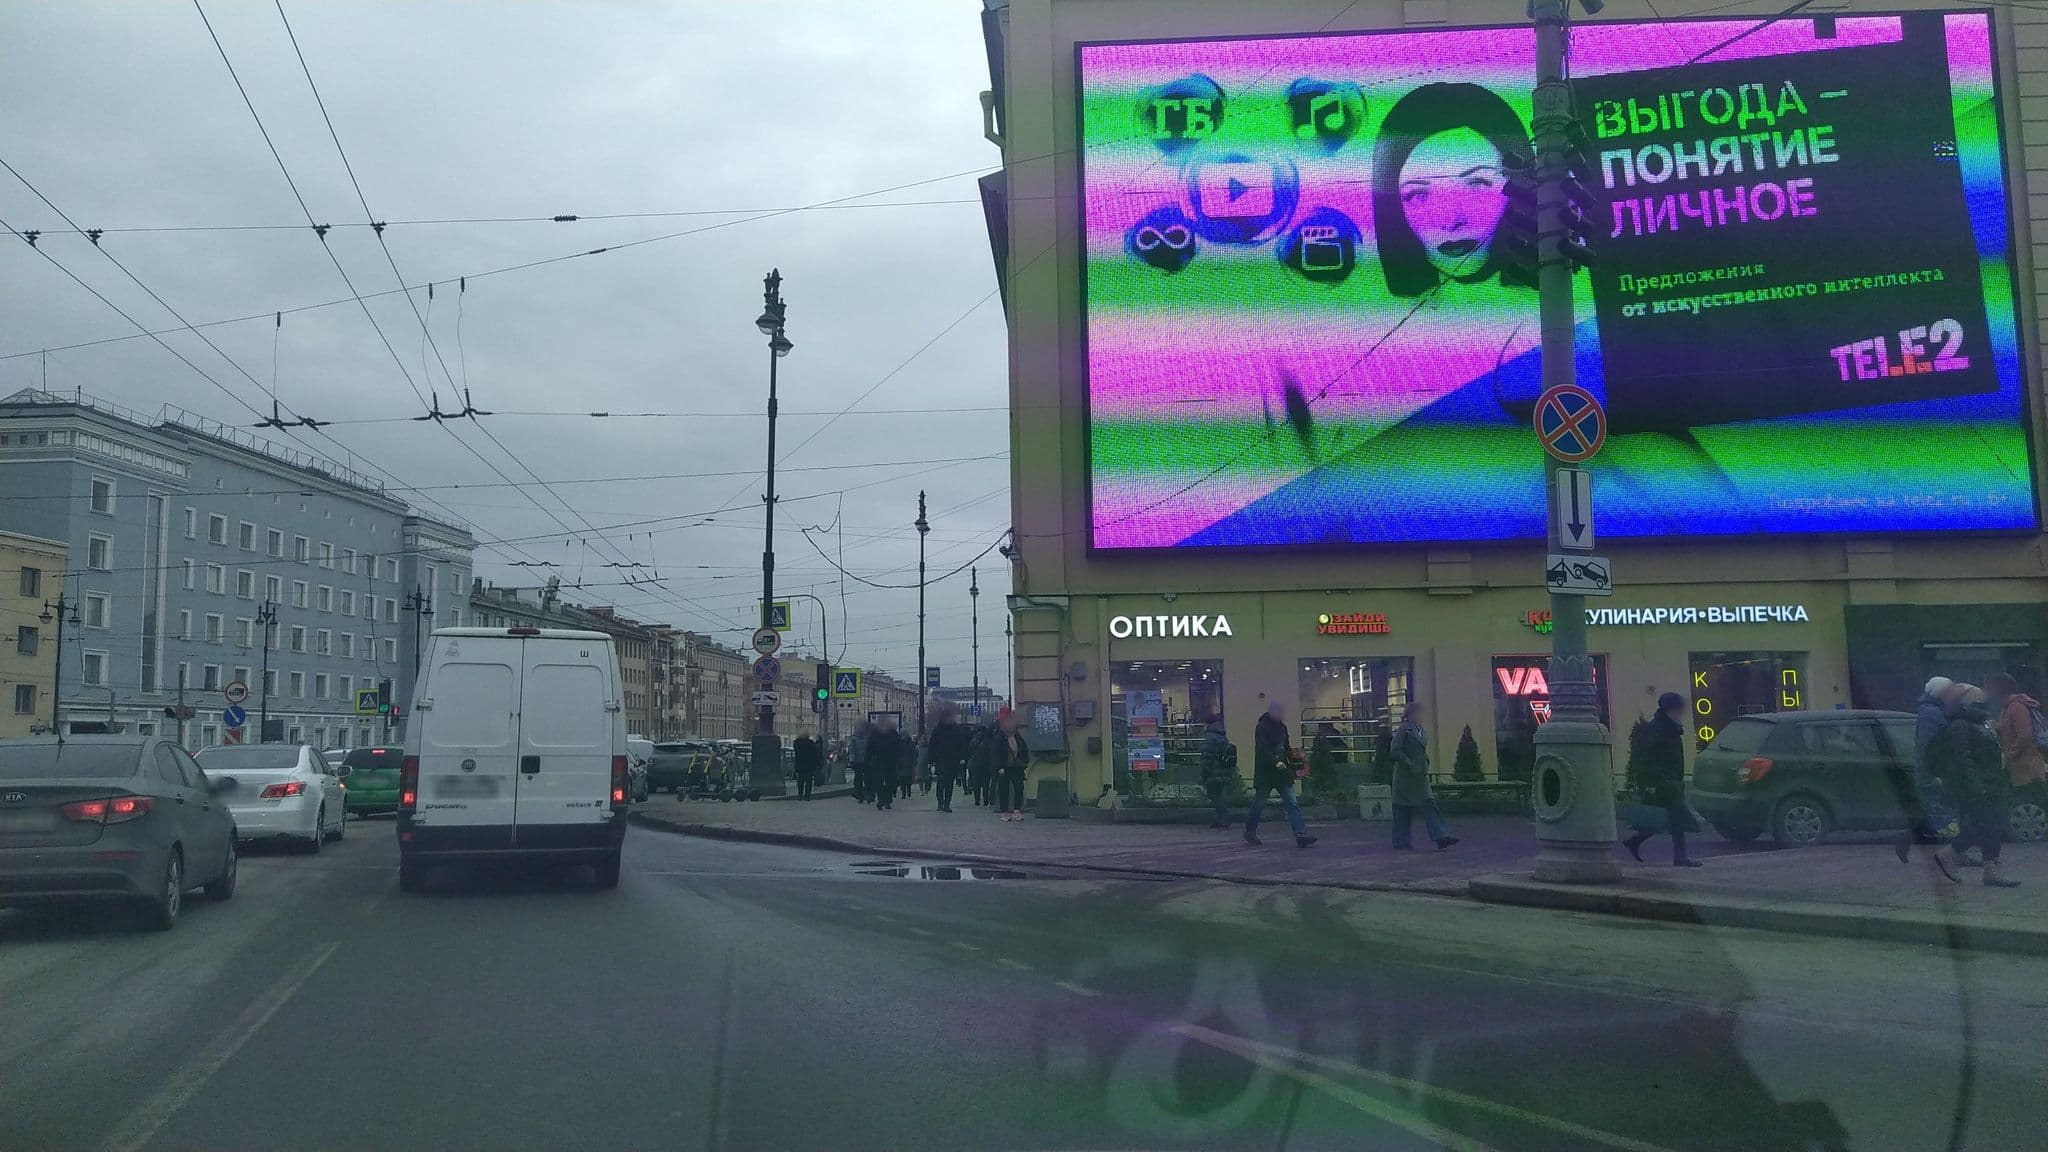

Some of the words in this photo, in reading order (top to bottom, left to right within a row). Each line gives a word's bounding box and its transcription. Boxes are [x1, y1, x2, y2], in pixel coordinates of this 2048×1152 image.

[1153, 98, 1214, 138] ГБ
[1594, 80, 1808, 139] ВЫГОДА
[1600, 125, 1840, 189] ПОНЯТИЕ
[1610, 177, 1818, 239] ЛИЧНОЕ
[1618, 264, 1766, 296] Предложения
[1621, 302, 1648, 318] от
[1652, 282, 1818, 316] искусственного
[1823, 268, 1945, 294] интеллекта
[1829, 318, 1970, 381] TELE2
[1109, 614, 1233, 638] ОПТИКА
[1318, 623, 1391, 634] УВИДИШЬ
[1334, 612, 1386, 622] ЗАЙДИ
